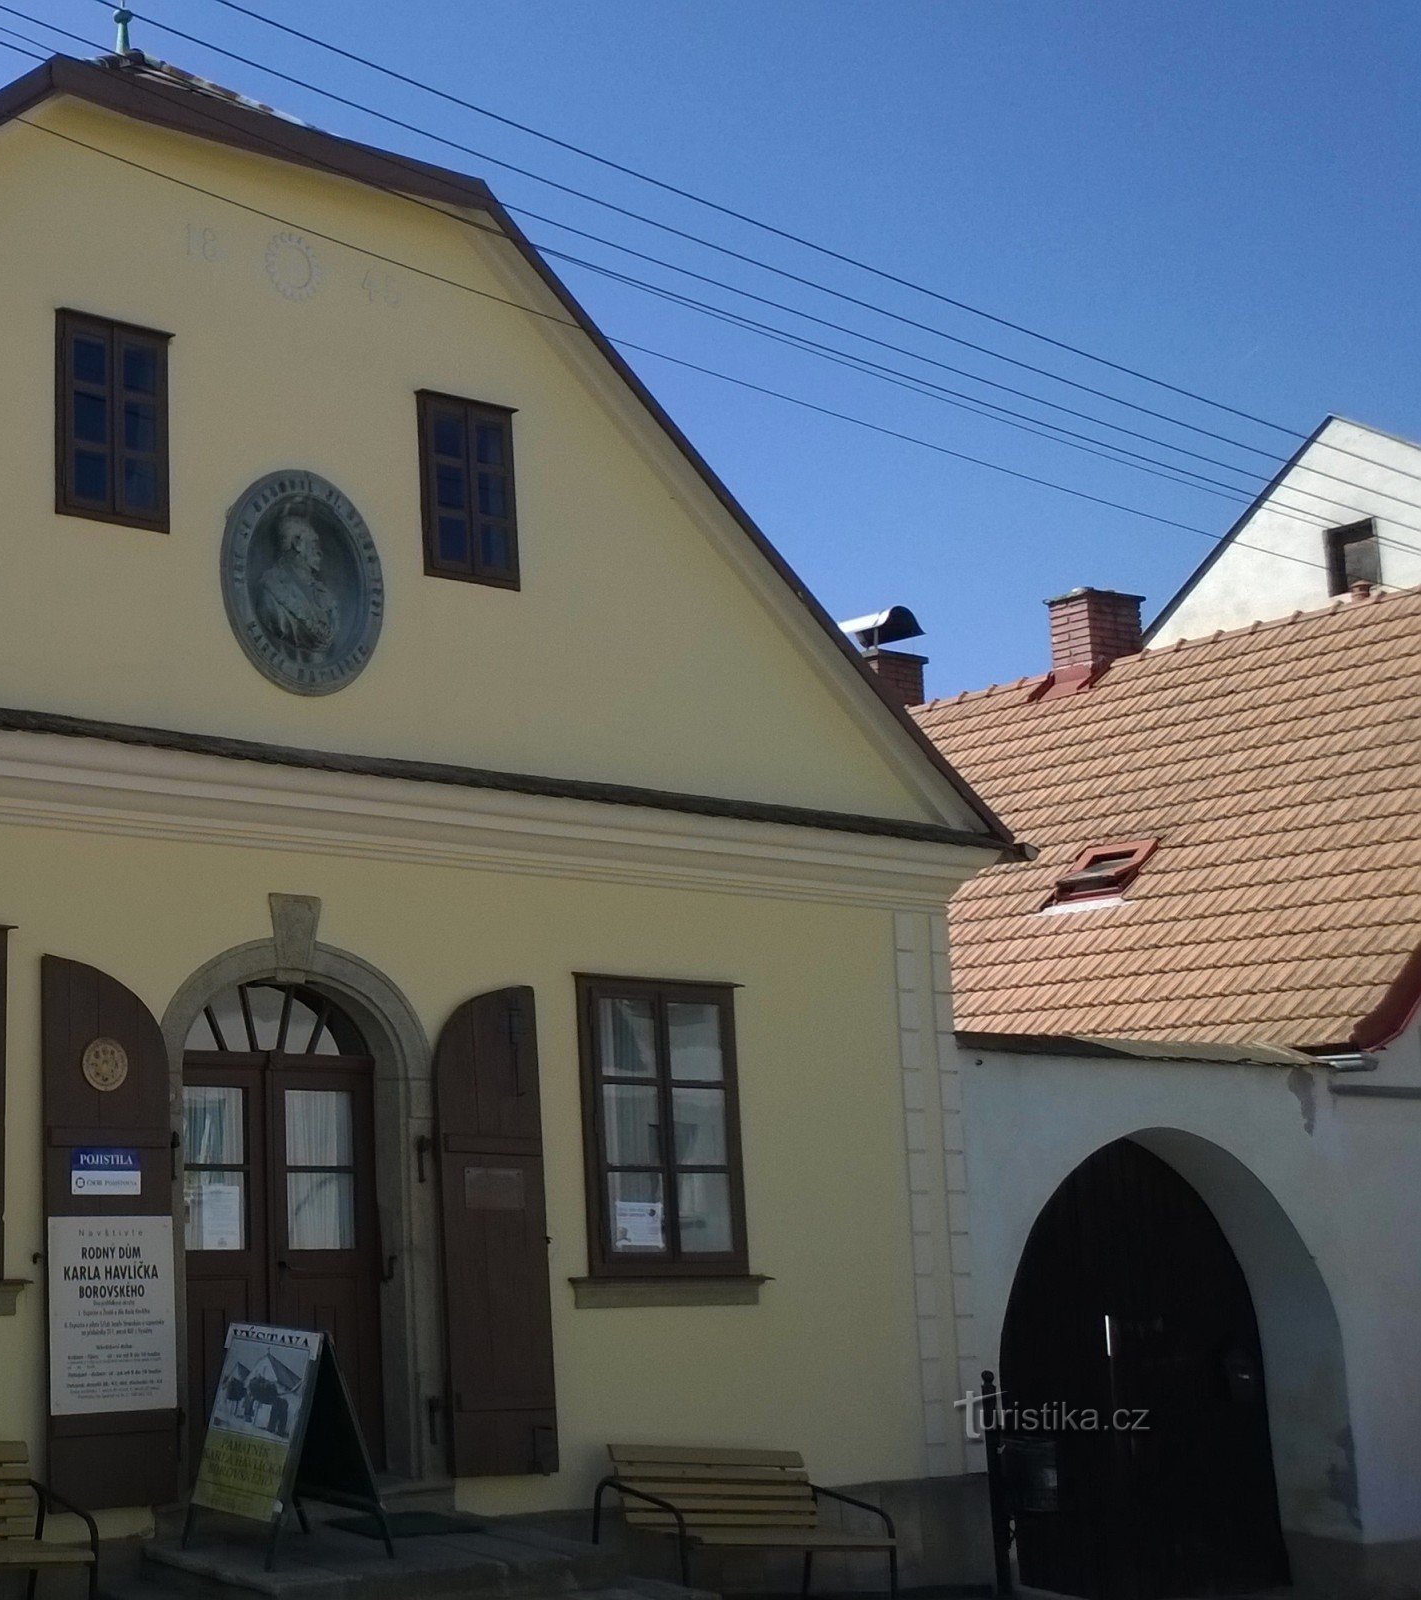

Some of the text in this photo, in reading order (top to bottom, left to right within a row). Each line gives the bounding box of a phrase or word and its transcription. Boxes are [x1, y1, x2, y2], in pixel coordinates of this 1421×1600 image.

[79, 1153, 134, 1166] POJISTILA
[81, 1243, 142, 1260] RODNÝ DŮM
[63, 1260, 159, 1281] KARLA HAVLÍČKA
[78, 1281, 146, 1299] BOROVSKÉHO
